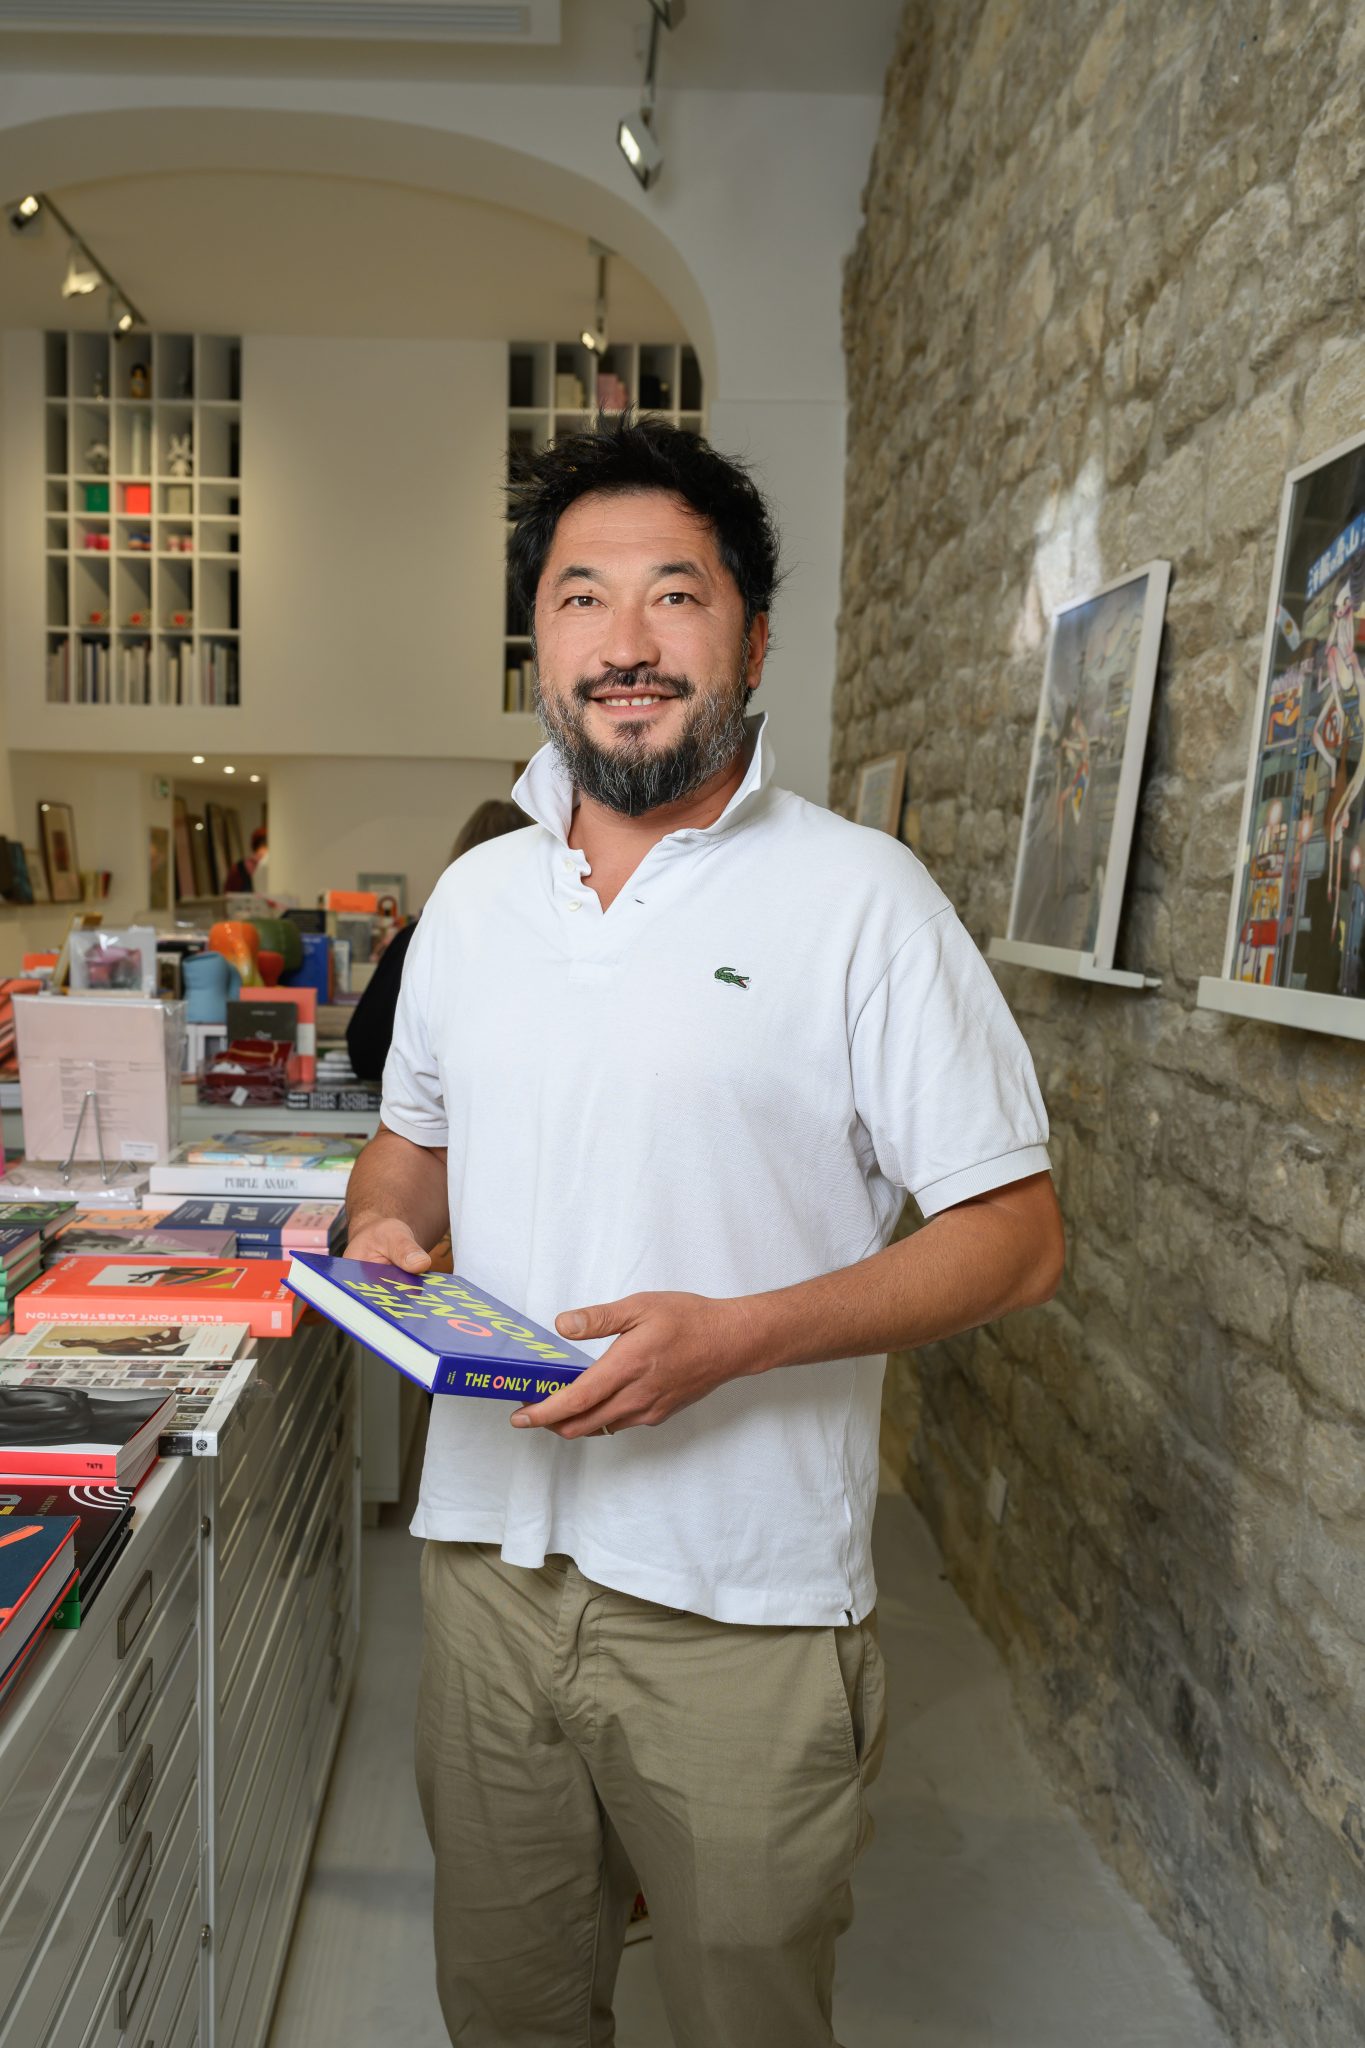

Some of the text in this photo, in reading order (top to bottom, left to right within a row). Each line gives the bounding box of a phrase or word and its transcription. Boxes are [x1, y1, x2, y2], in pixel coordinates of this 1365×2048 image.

[225, 1177, 259, 1189] PURPLE
[343, 1279, 428, 1319] THE
[379, 1276, 493, 1338] ONLY
[25, 1312, 224, 1322] ELLES FONT L'ABSTRACTION
[418, 1272, 570, 1359] WOMAN
[465, 1372, 492, 1388] THE
[492, 1375, 532, 1392] ONLY
[86, 1462, 103, 1470] TATE
